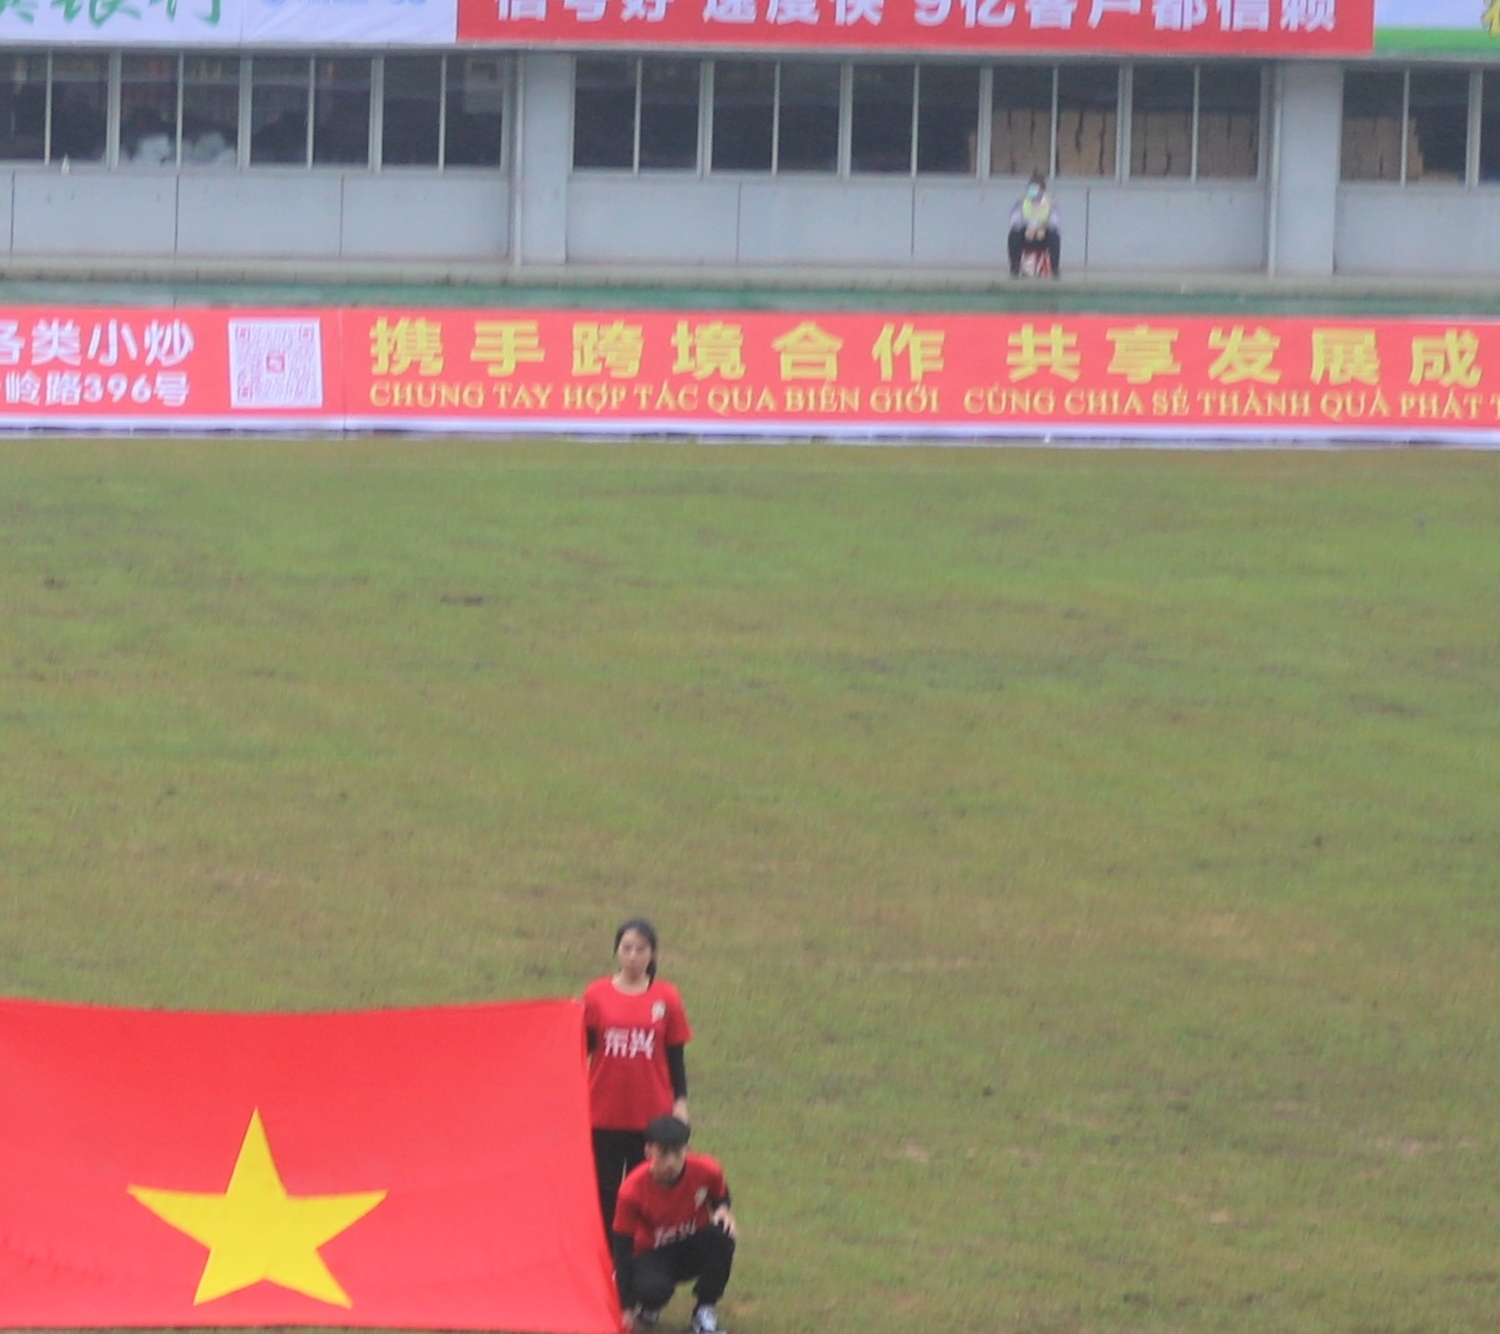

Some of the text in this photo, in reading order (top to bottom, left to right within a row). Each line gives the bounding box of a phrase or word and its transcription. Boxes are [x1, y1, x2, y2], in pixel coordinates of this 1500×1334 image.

[370, 319, 1483, 388] 携手跨境合作 共享发展成
[369, 382, 485, 408] CHUNG
[493, 383, 552, 409] TAY
[707, 385, 778, 414] QUA
[1064, 388, 1145, 414] CHIA
[604, 1027, 656, 1060] 东兴
